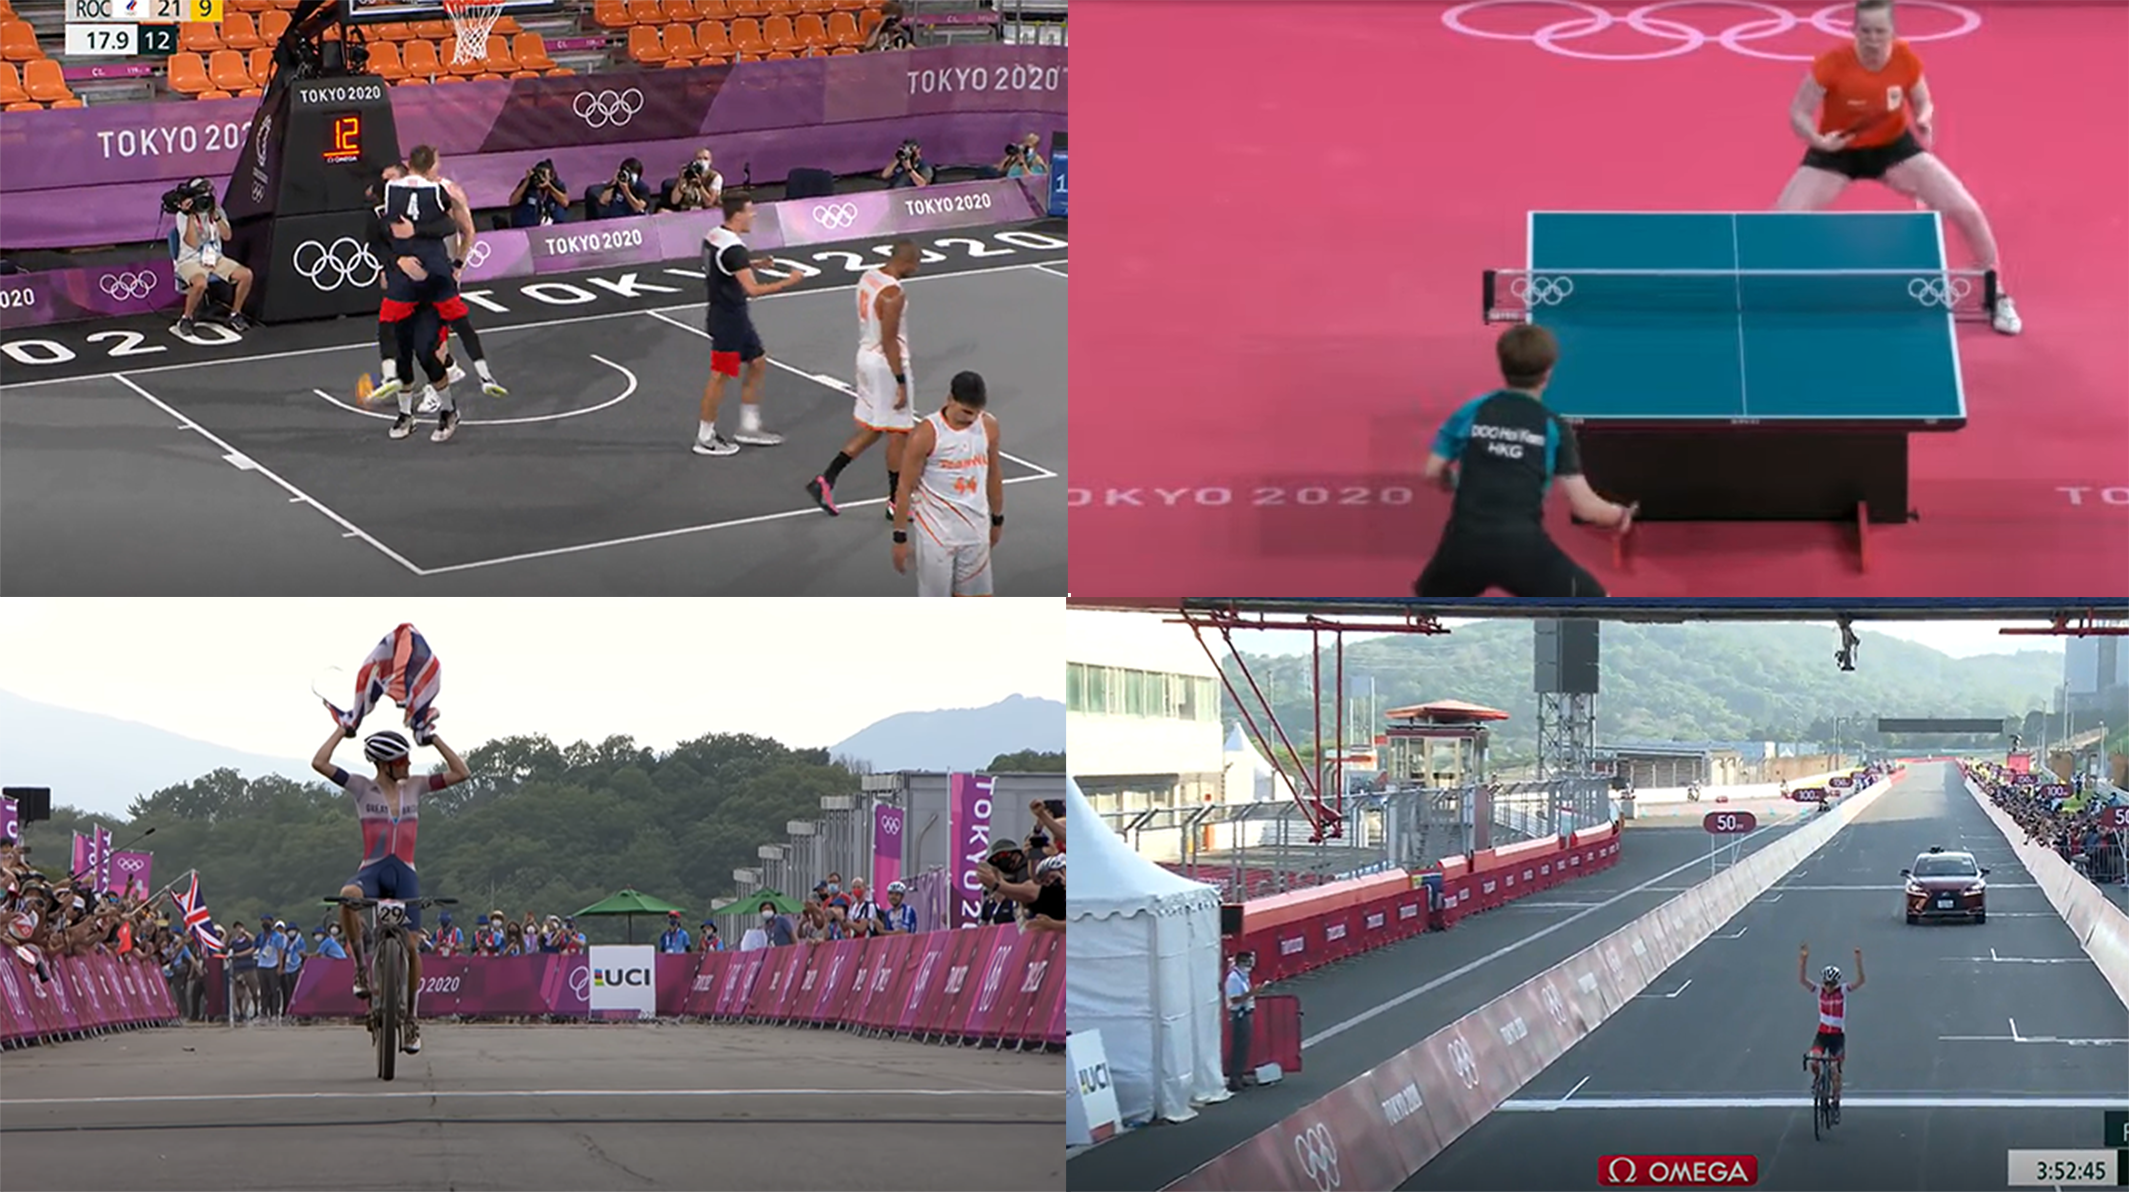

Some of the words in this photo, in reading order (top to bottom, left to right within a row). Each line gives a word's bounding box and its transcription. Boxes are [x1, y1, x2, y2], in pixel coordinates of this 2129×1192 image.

[907, 67, 988, 94] TOKYO
[994, 66, 1059, 91] 2020
[300, 87, 346, 103] TOKYO
[348, 85, 381, 100] 2020
[97, 126, 197, 158] TOKYO
[335, 117, 358, 149] 12
[406, 192, 420, 220] 4
[905, 197, 954, 216] TOKYO
[956, 193, 992, 210] 2020
[545, 233, 601, 256] TOKYO
[603, 229, 643, 249] 2020
[459, 257, 822, 313] TOKO
[1487, 442, 1524, 459] HKG
[1252, 487, 1414, 505] 2020
[2055, 486, 2129, 505] TO
[380, 906, 403, 923] 29
[427, 976, 460, 992] 2020
[605, 968, 651, 986] UCI
[1087, 1062, 1111, 1093] UCI
